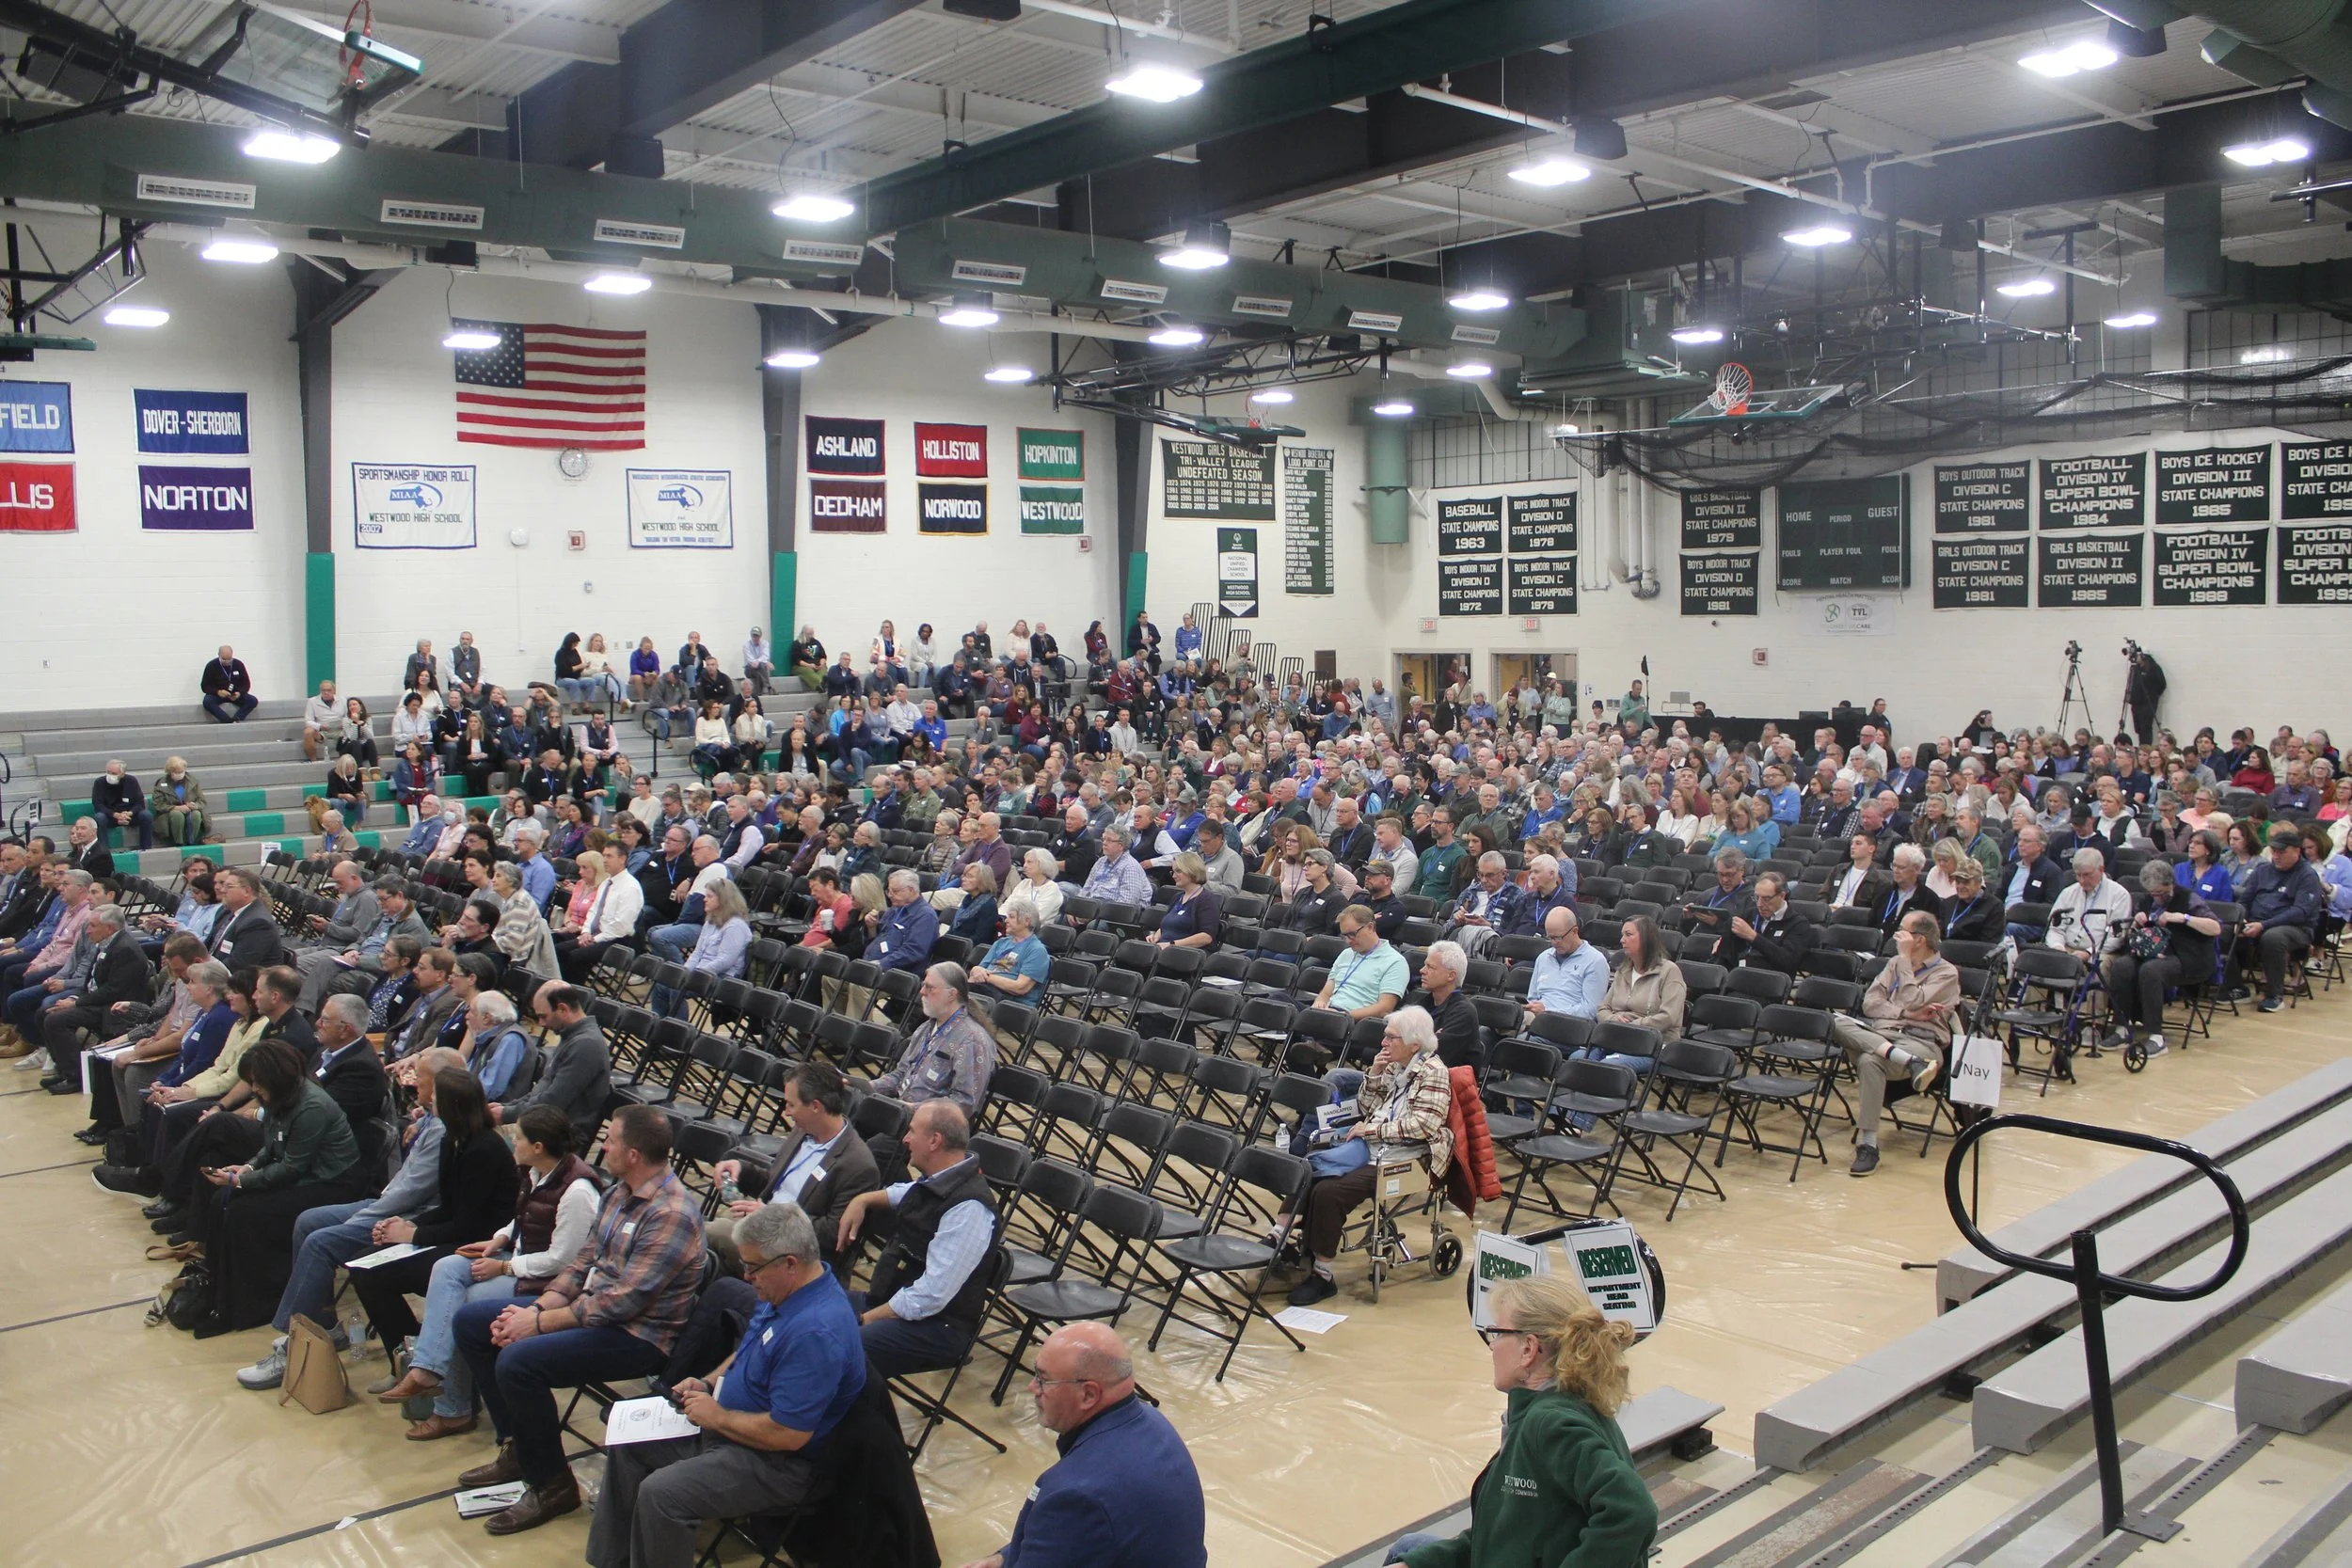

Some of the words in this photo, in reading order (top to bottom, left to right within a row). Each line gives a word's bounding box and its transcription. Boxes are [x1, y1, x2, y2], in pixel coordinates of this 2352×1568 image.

[143, 409, 241, 436] DOVER-SHERBORN
[816, 436, 877, 457] ASHLAND
[923, 440, 979, 461] HOLLISTON
[1171, 442, 1203, 455] WESTWOOD
[1208, 444, 1225, 456] GIRLS
[1025, 445, 1076, 465] HOPKINTON
[2288, 449, 2320, 461] BOYS
[2325, 447, 2344, 459] ICE
[1231, 459, 1260, 468] LEAGUE
[2051, 458, 2133, 473] FOOTBALL
[2162, 457, 2190, 469] BOYS
[2195, 454, 2213, 467] ICE
[2217, 452, 2265, 466] HOCKEY
[359, 468, 420, 481] SPORTSMANSHIP
[424, 470, 447, 481] HONOR
[452, 471, 469, 482] ROLL
[1177, 467, 1228, 480] UNDEFEATED
[1232, 469, 1263, 482] SEASON
[1939, 470, 1958, 482] BOYS
[1962, 468, 1995, 480] OUTDOOR
[2000, 467, 2025, 478] TRACK
[2057, 473, 2108, 486] DIVISION
[2112, 472, 2126, 483] IV
[2172, 471, 2229, 485] DIVISION
[2233, 470, 2251, 482] III
[1953, 484, 1998, 497] DIVISION
[2002, 483, 2010, 494] C
[2044, 488, 2094, 500] SUPER
[2098, 485, 2140, 498] BOWL
[2162, 489, 2196, 501] STATE
[2200, 485, 2265, 499] CHAMPIONS
[2287, 483, 2326, 496] STATE
[145, 485, 246, 511] NORTON
[1514, 500, 1528, 510] BOYS
[1530, 499, 1549, 509] INDOOR
[1552, 498, 1570, 507] TRACK
[815, 496, 882, 517] DEDHAM
[925, 499, 981, 519] NORWOOD
[1022, 501, 1082, 520] WESTWOOD
[1445, 504, 1494, 517] BASEBALL
[1695, 505, 1734, 515] DIVISION
[1737, 504, 1746, 514] II
[1867, 506, 1899, 518] GUEST
[1940, 501, 1968, 513] STATE
[1972, 499, 2025, 510] CHAMPIONS
[2050, 499, 2134, 514] CHAMPIONS
[2192, 504, 2231, 517] 1985
[369, 513, 410, 522] WESTWOOD
[414, 514, 430, 522] HIGH
[435, 514, 462, 523] SCHOOL
[1521, 512, 1553, 522] DIVISION
[1786, 512, 1812, 522] HOME
[1829, 515, 1851, 523] PERIOD
[1967, 515, 1995, 527] 1981
[2073, 514, 2108, 525] 1984
[696, 523, 720, 531] SCHOOL
[1441, 522, 1461, 533] STATE
[1463, 520, 1499, 532] CHAMPIONS
[1512, 526, 1533, 535] STATE
[1535, 524, 1573, 534] CHAMPIONS
[1686, 520, 1709, 530] STATE
[1712, 517, 1756, 529] CHAMPIONS
[1455, 537, 1485, 549] 1963
[1707, 533, 1734, 543] 1979
[2167, 533, 2254, 547] FOOTBALL
[1782, 549, 1801, 558] FOULS
[1820, 547, 1843, 556] PLAYER
[1938, 546, 1959, 557] GIRLS
[1963, 545, 1995, 556] OUTDOOR
[1999, 544, 2024, 555] TRACK
[2050, 543, 2073, 554] GIRLS
[2076, 541, 2130, 553] BASKETBALL
[2294, 544, 2351, 556] DIVISION
[2172, 548, 2227, 562] DIVISION
[2231, 547, 2247, 559] IV
[1445, 565, 1457, 575] BOYS
[1459, 564, 1477, 574] INDOOR
[1480, 563, 1496, 573] TRACK
[1515, 563, 1528, 573] BOYS
[1531, 562, 1549, 572] INDOOR
[1552, 562, 1570, 571] TRACK
[1687, 560, 1703, 570] BOYS
[1706, 559, 1727, 569] INDOOR
[1730, 558, 1751, 569] TRACK
[1951, 561, 1997, 572] DIVISION
[2001, 561, 2010, 570] C
[2057, 558, 2106, 570] DIVISION
[2111, 558, 2122, 568] II
[2158, 563, 2212, 576] SUPER
[2217, 562, 2261, 574] BOWL
[2283, 559, 2343, 571] SUPER
[1451, 577, 1482, 586] DIVISION
[1521, 575, 1554, 585] DIVISION
[1557, 575, 1564, 584] C
[1695, 573, 1733, 583] DIVISION
[1782, 578, 1802, 586] SCORE
[1938, 577, 1966, 587] STATE
[1970, 575, 2024, 586] CHAMPIONS
[2043, 574, 2074, 585] STATE
[2078, 573, 2137, 584] CHAMPIONS
[2163, 577, 2254, 590] CHAMPIONS
[1442, 590, 1461, 599] STATE
[1464, 589, 1500, 598] CHAMPIONS
[1512, 589, 1533, 598] STATE
[1535, 587, 1573, 597] CHAMPIONS
[1685, 588, 1708, 597] STATE
[1710, 586, 1754, 596] CHAMPIONS
[1965, 592, 1994, 601] 1981
[2072, 590, 2106, 601] 1985
[2189, 591, 2228, 602] 1988
[1460, 602, 1482, 611] 1972
[1963, 1063, 1990, 1080] Nay
[1324, 1106, 1352, 1115] HANDICAPPED
[1577, 1244, 1637, 1278] RESERVED
[1588, 1282, 1641, 1293] DEPARTMENT
[1607, 1292, 1629, 1301] HEAD
[1602, 1301, 1637, 1310] SEATING
